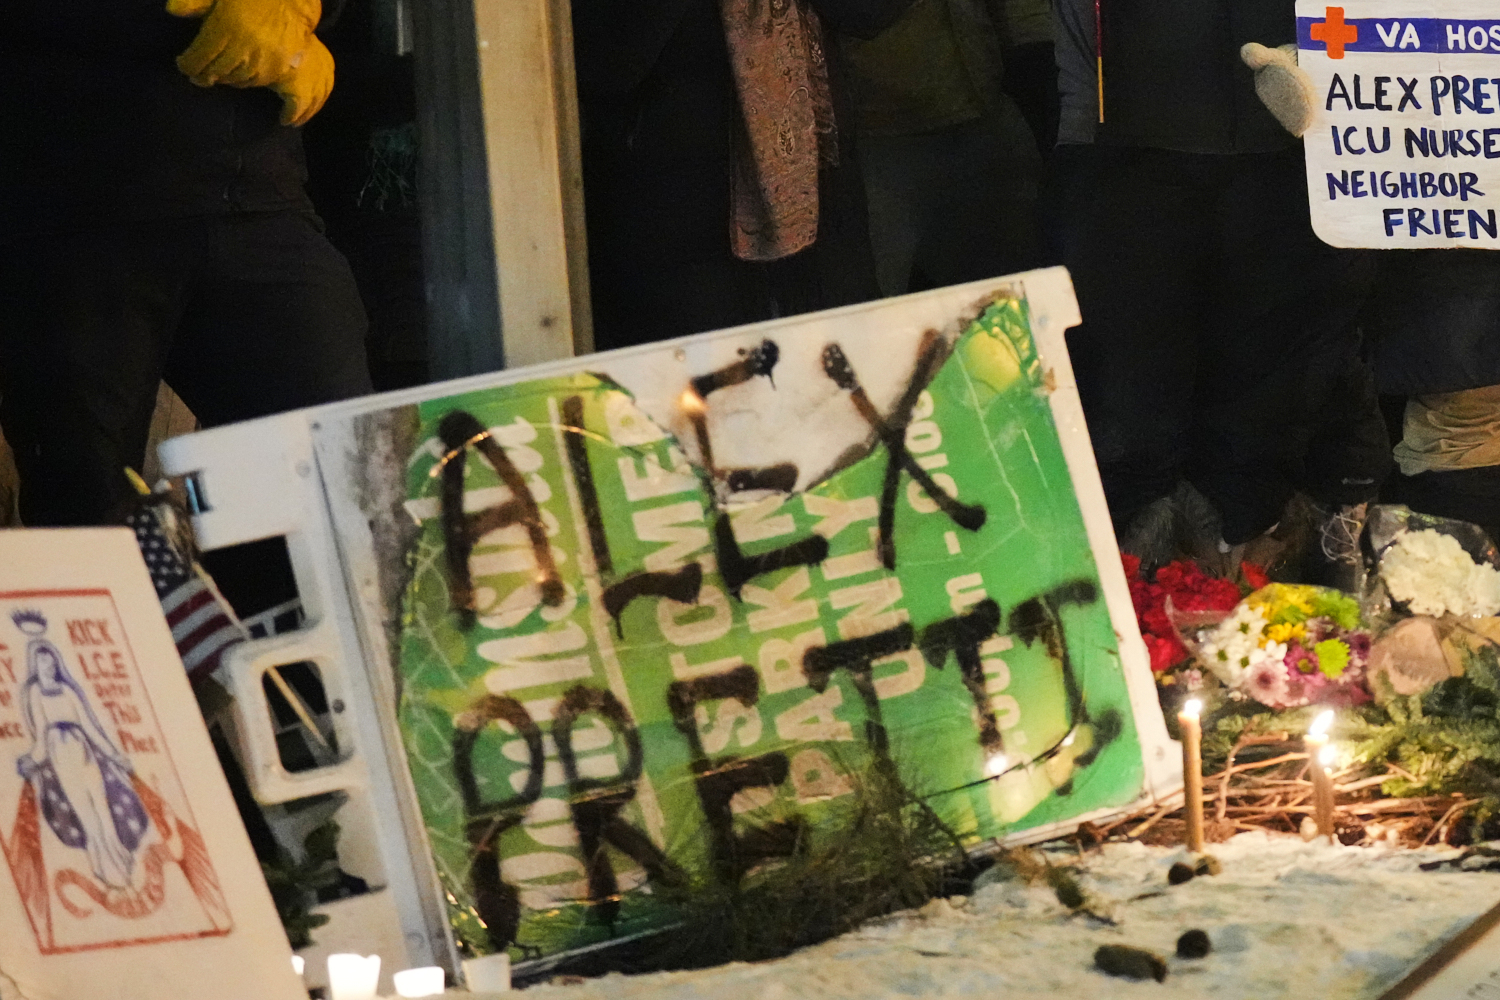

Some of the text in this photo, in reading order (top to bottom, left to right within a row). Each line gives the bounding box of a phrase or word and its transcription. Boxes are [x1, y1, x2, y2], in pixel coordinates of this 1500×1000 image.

[1375, 21, 1421, 49] VA
[1325, 72, 1423, 113] ALEX
[1331, 125, 1392, 156] ICU
[1326, 169, 1486, 201] NEIGHBOR
[437, 328, 987, 634] ALEX
[65, 618, 115, 646] KICK
[453, 579, 1123, 951] PRETTI
